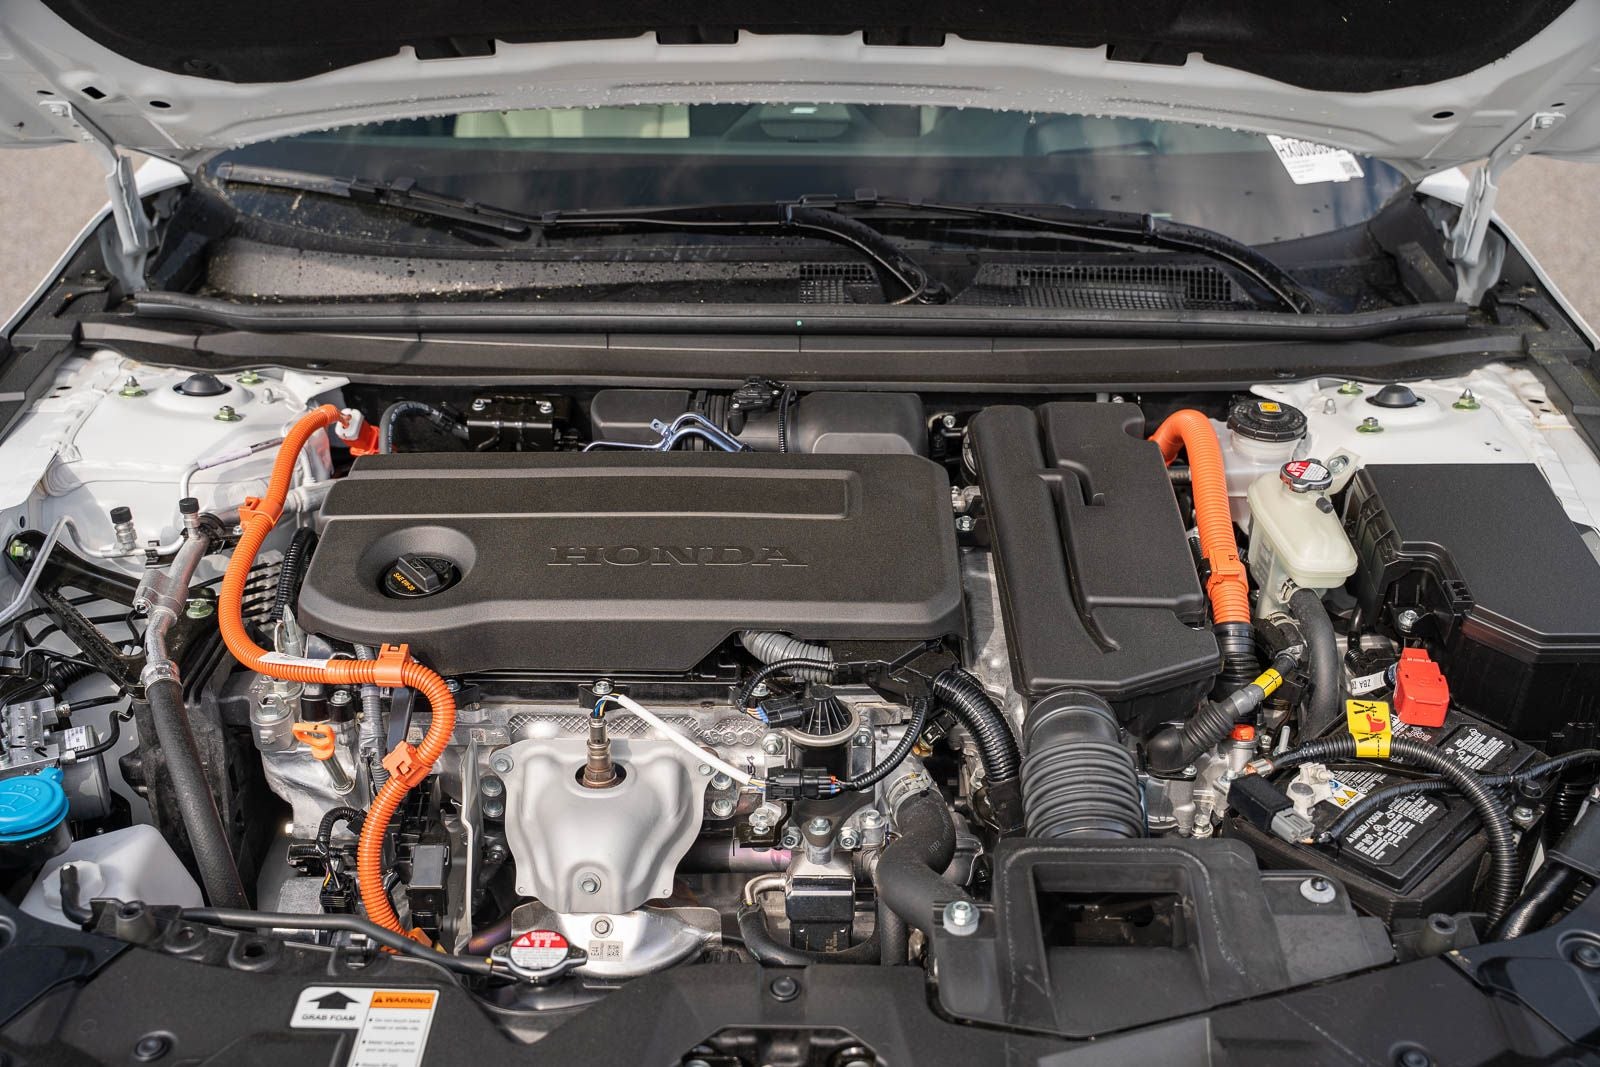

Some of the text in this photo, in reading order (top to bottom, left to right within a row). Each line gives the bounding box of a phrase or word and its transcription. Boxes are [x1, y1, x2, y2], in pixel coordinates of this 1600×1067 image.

[547, 544, 809, 567] HONDA
[385, 996, 431, 1004] WARNING
[302, 1013, 328, 1021] GRAB
